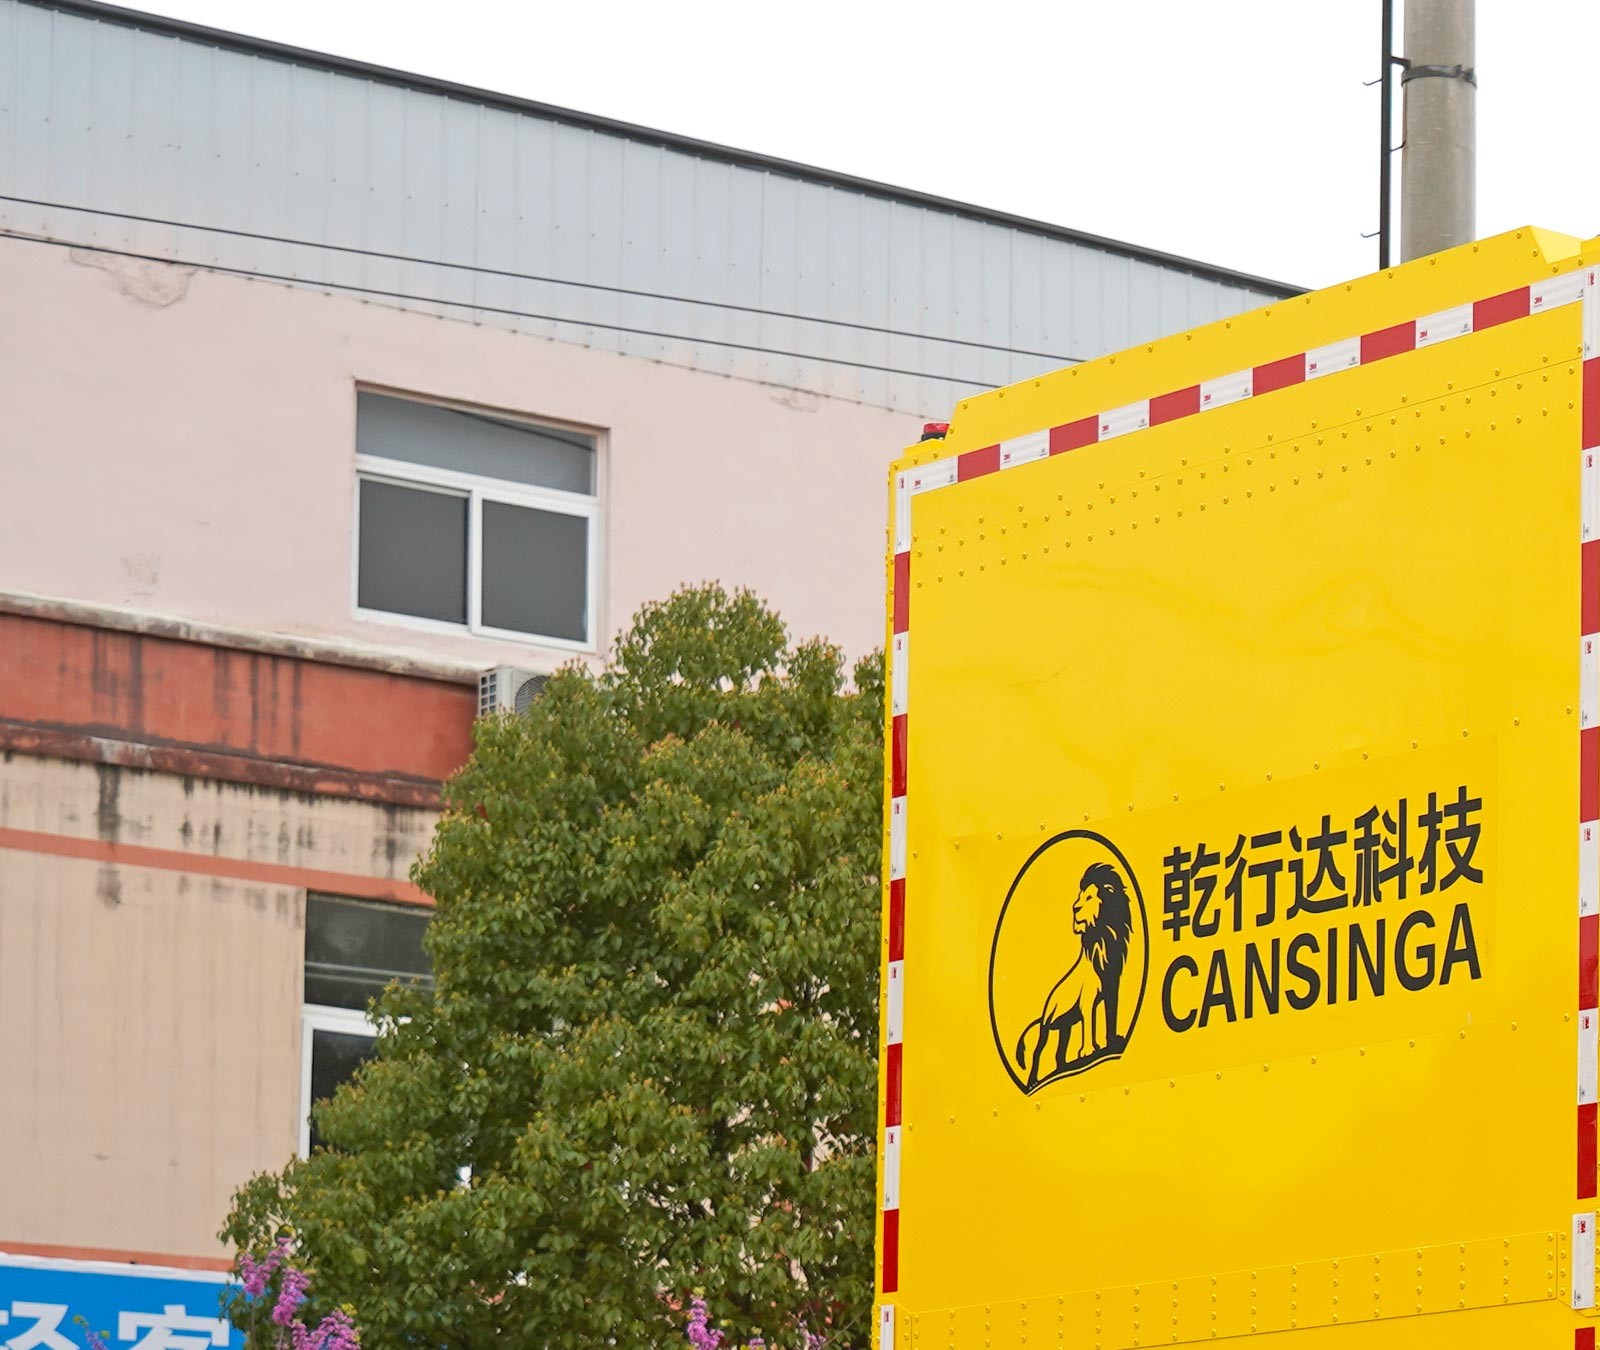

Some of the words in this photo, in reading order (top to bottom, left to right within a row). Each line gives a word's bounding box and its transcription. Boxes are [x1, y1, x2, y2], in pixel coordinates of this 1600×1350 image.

[1162, 785, 1484, 942] 乾行达科技
[1161, 902, 1483, 1033] CANSINGA
